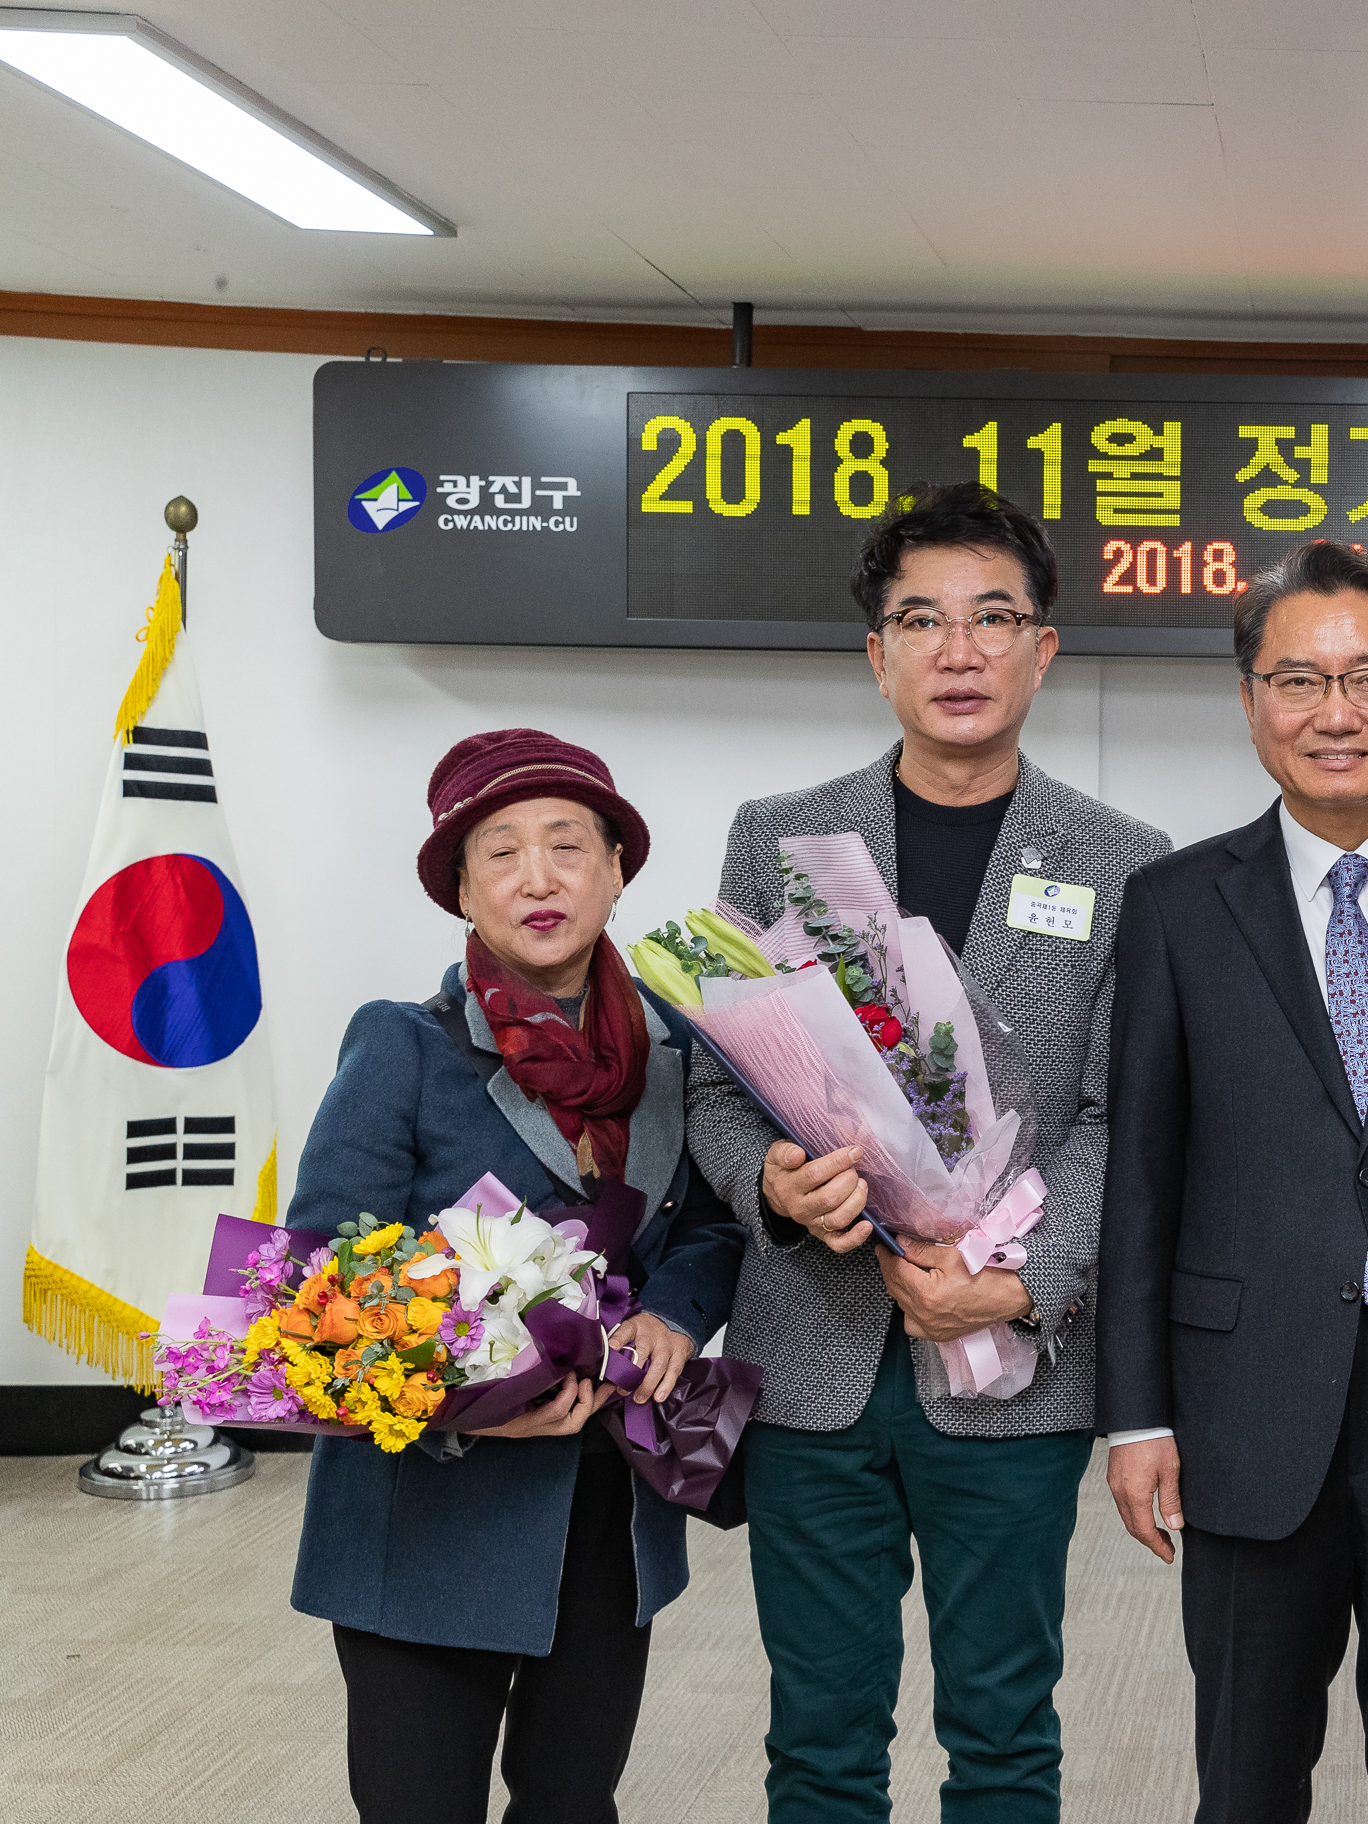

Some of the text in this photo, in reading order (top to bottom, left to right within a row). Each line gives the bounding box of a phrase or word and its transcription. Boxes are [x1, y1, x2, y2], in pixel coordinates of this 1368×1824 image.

[436, 475, 582, 510] 광진구
[962, 419, 1182, 526] 11월
[437, 514, 578, 532] GWANGJIN-GU
[1102, 540, 1248, 594] 2018.
